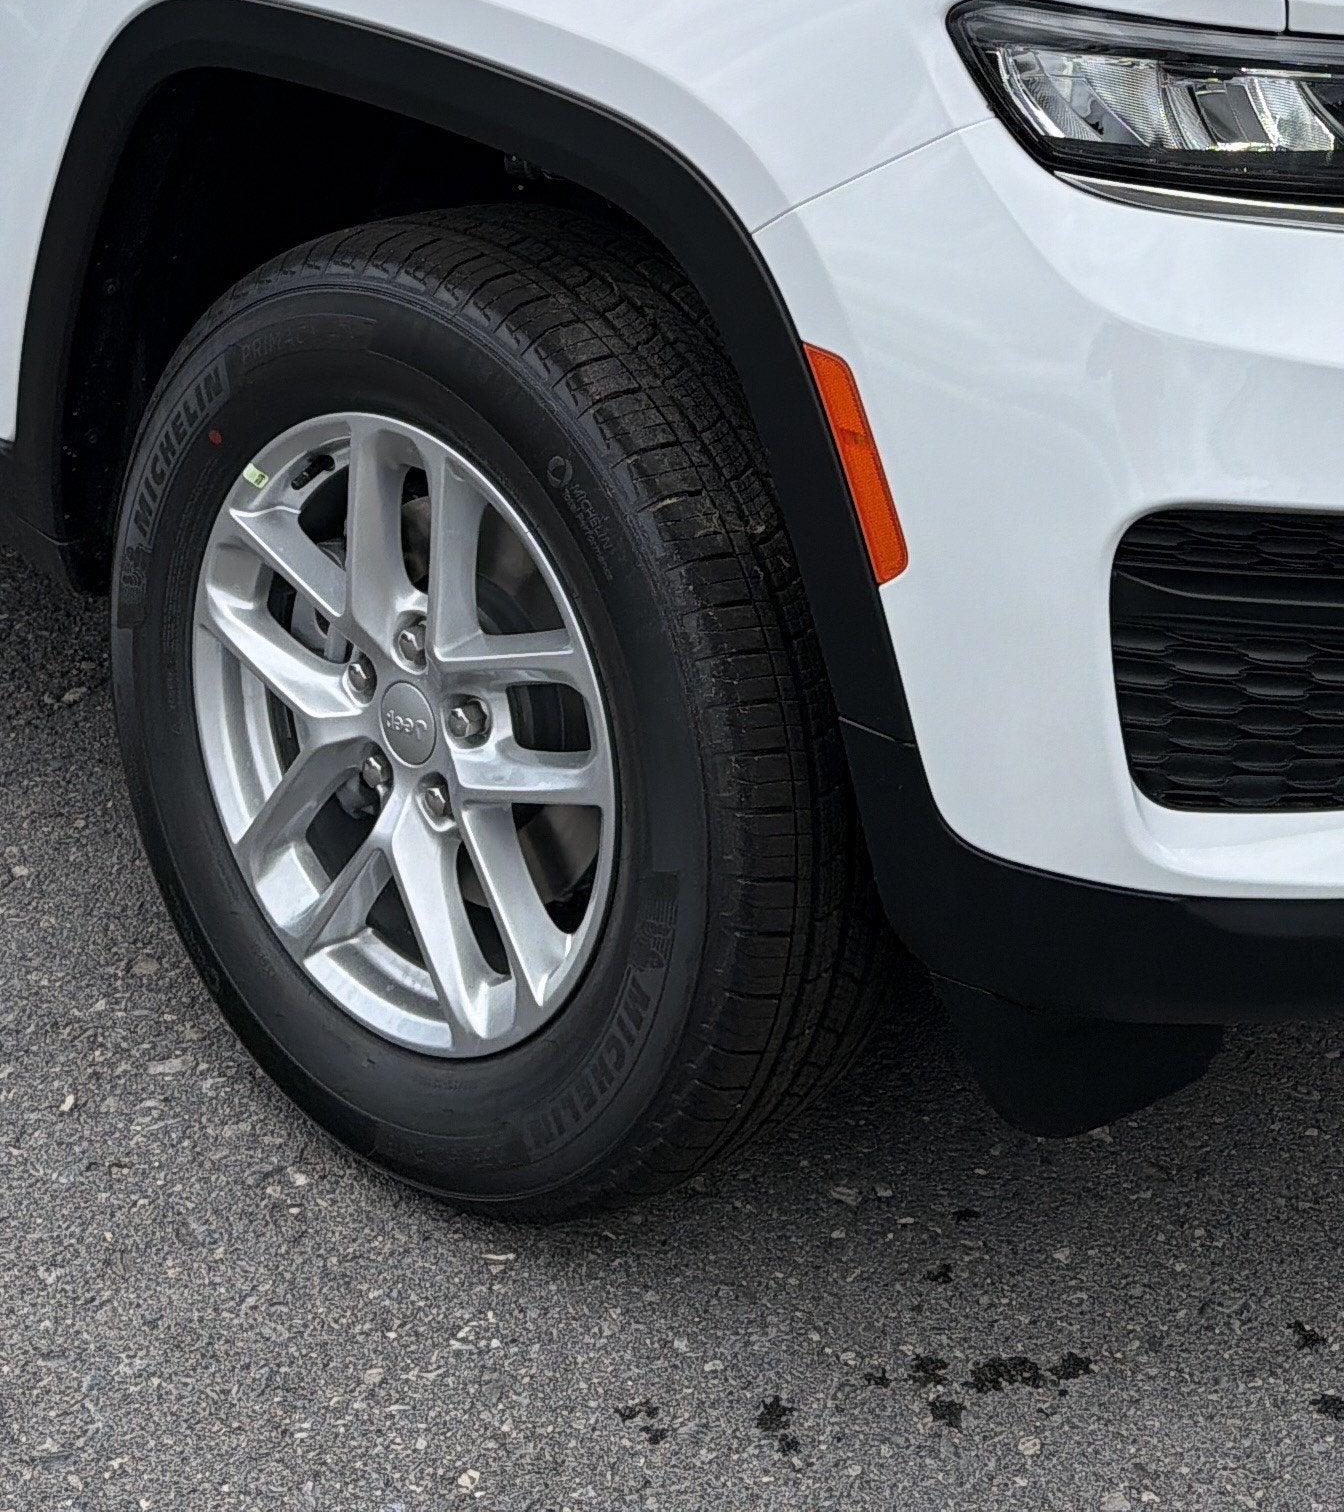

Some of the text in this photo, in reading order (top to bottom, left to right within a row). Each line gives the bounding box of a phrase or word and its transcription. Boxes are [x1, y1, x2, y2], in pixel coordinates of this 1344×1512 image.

[133, 364, 226, 539] MICHELIN
[385, 709, 428, 741] Jeep
[526, 972, 653, 1154] MICHELIN
